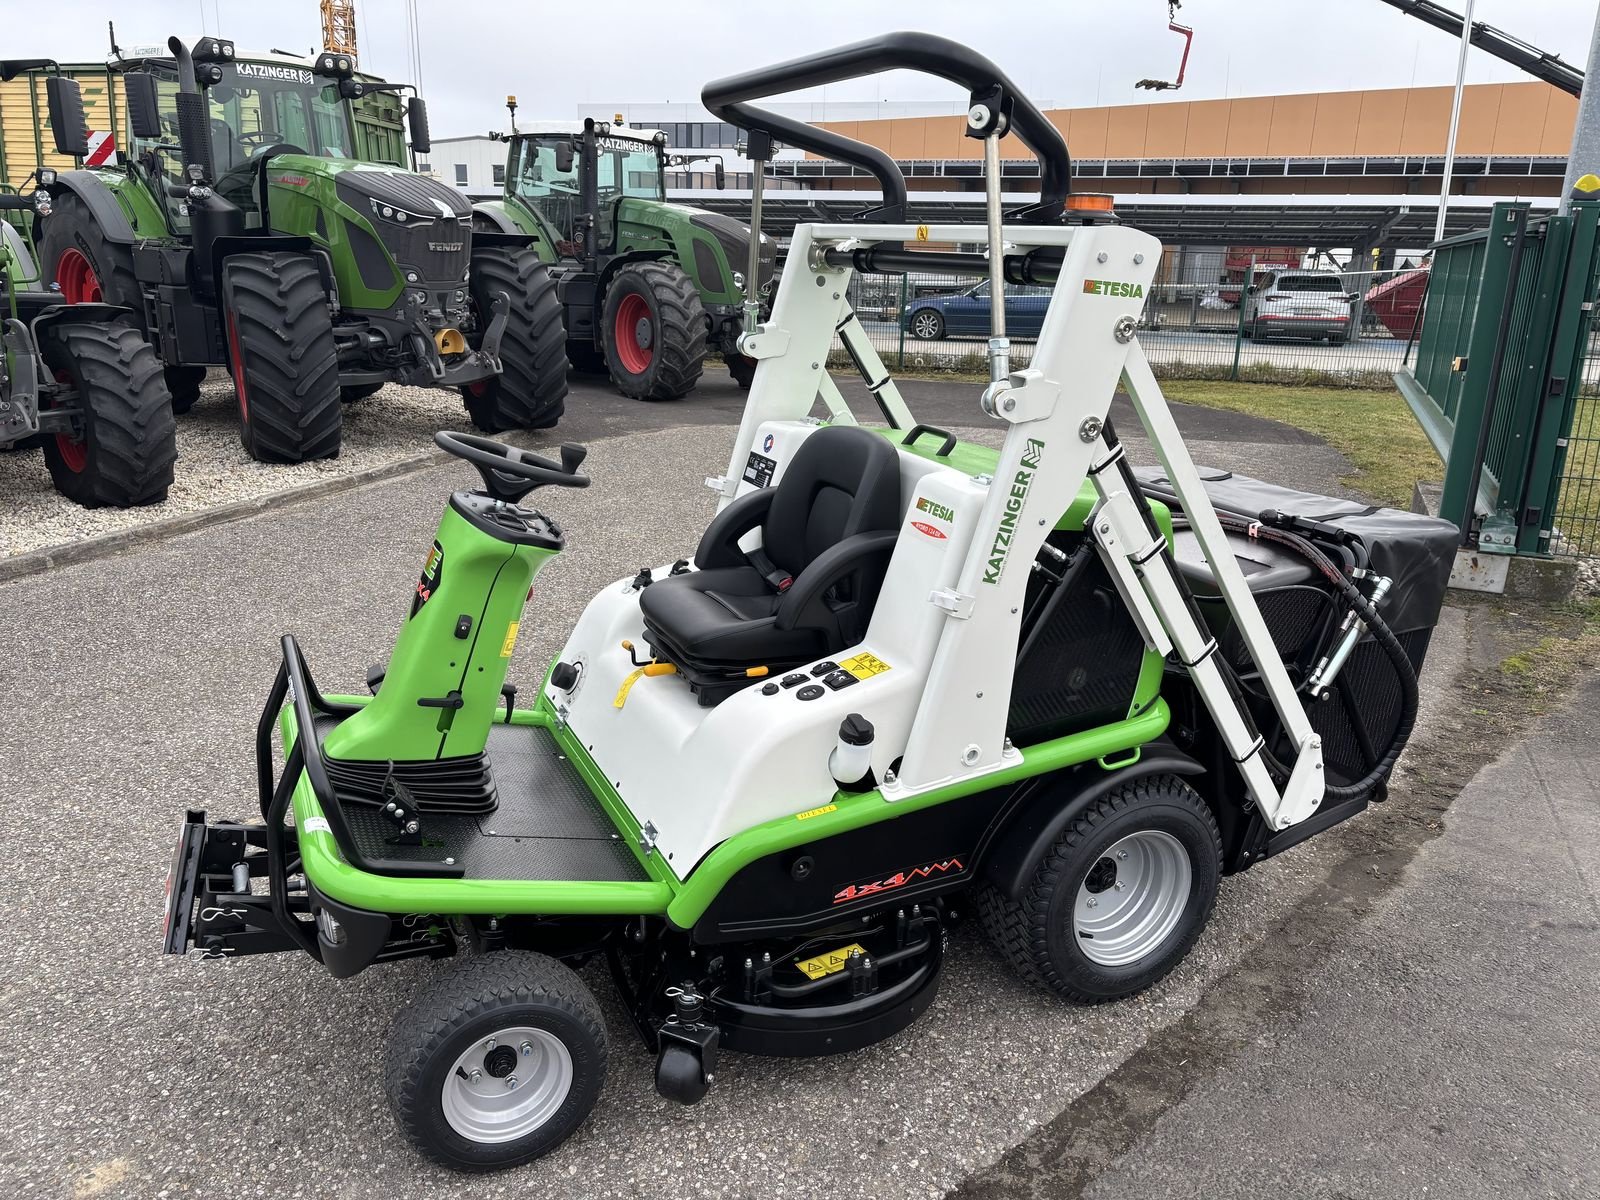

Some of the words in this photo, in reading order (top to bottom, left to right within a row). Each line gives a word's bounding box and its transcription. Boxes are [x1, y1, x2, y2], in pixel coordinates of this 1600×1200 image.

[236, 63, 298, 80] KATZINGER
[598, 136, 644, 153] KATZINGER
[428, 242, 464, 251] FENDT
[1083, 279, 1143, 299] ETESIA
[916, 497, 954, 523] ETESIA
[982, 470, 1032, 585] KATZINGER
[800, 805, 833, 819] DIESEL
